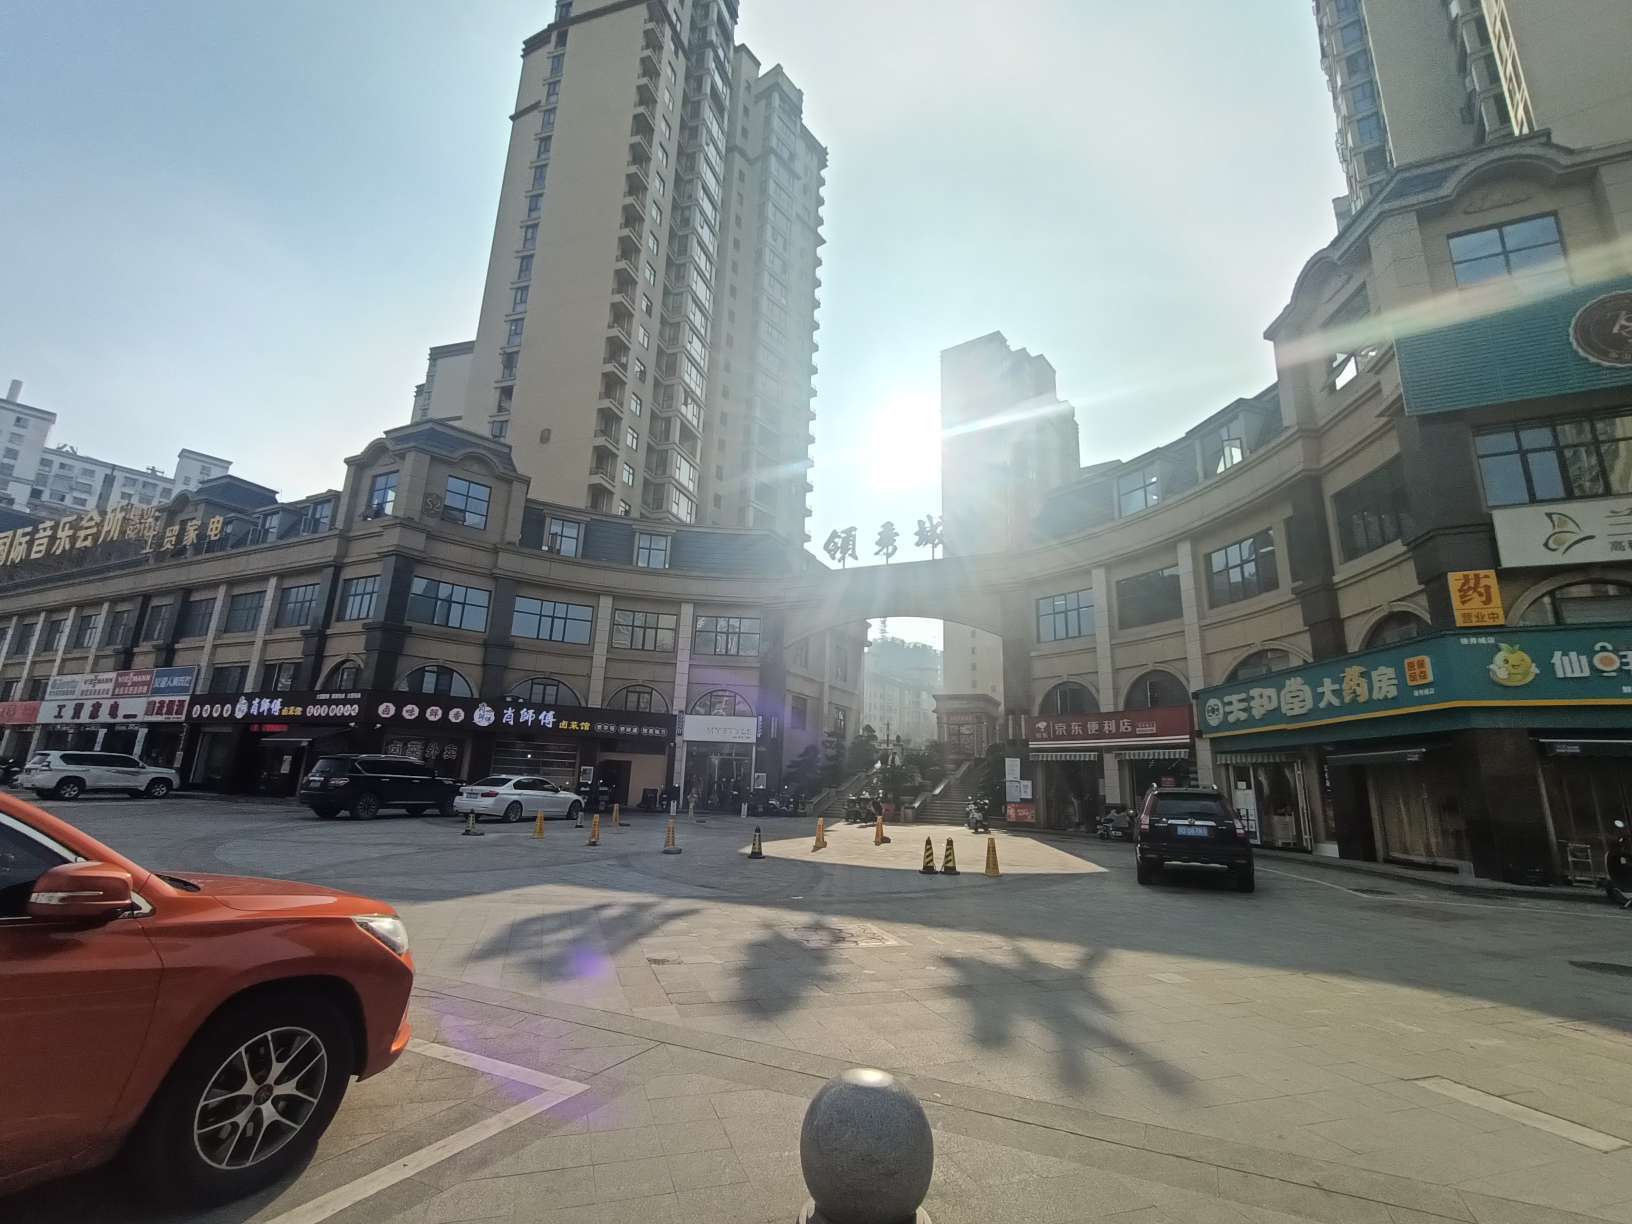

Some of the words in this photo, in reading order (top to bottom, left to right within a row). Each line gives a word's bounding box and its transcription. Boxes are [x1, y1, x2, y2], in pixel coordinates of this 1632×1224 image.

[1454, 573, 1492, 606] 药
[1462, 612, 1499, 624] 营业中
[559, 719, 592, 731] 卤菜馆
[1055, 719, 1132, 736] 京东便利店
